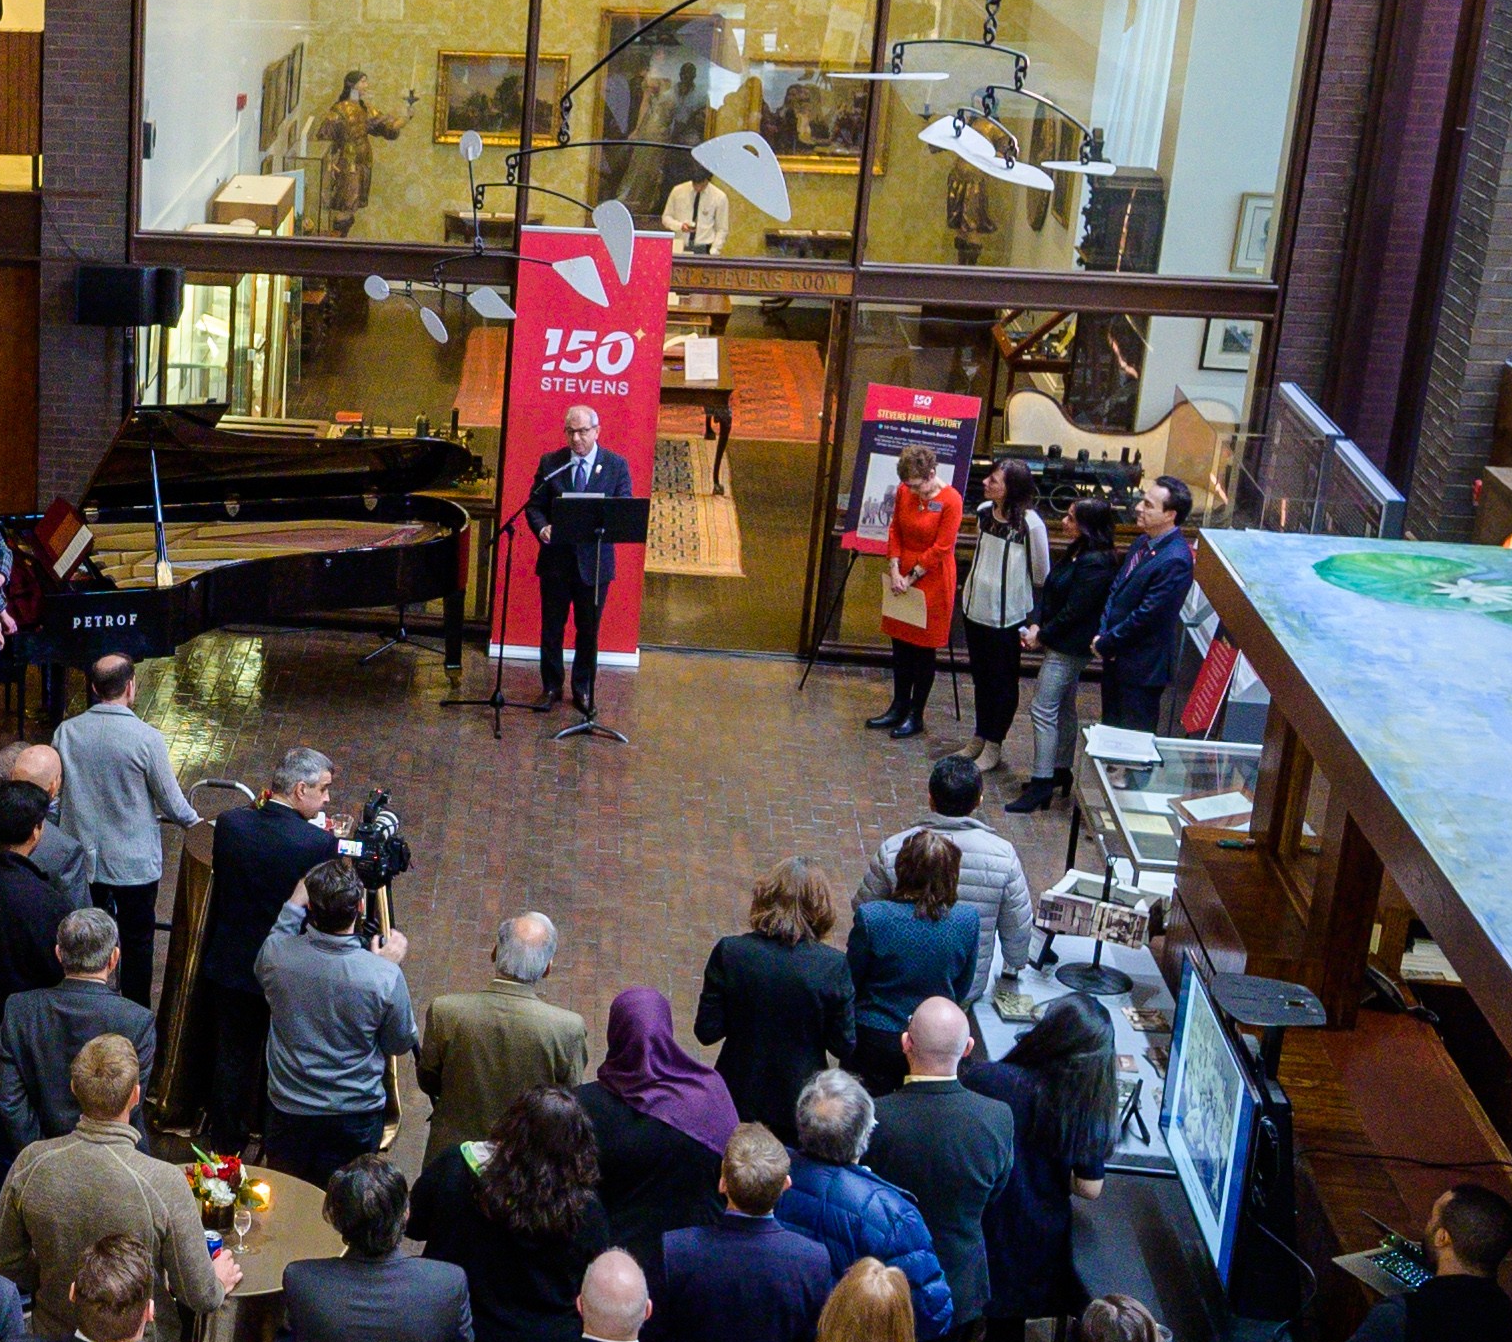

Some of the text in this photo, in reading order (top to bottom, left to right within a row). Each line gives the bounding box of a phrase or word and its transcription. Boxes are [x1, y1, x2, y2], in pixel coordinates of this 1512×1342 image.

[699, 268, 787, 289] STEVENS
[791, 273, 840, 291] ROOM
[541, 328, 635, 376] 150
[540, 377, 629, 395] STEVENS
[877, 408, 963, 429] STEVENS FAMILY HISTORY
[72, 613, 138, 629] PETROF
